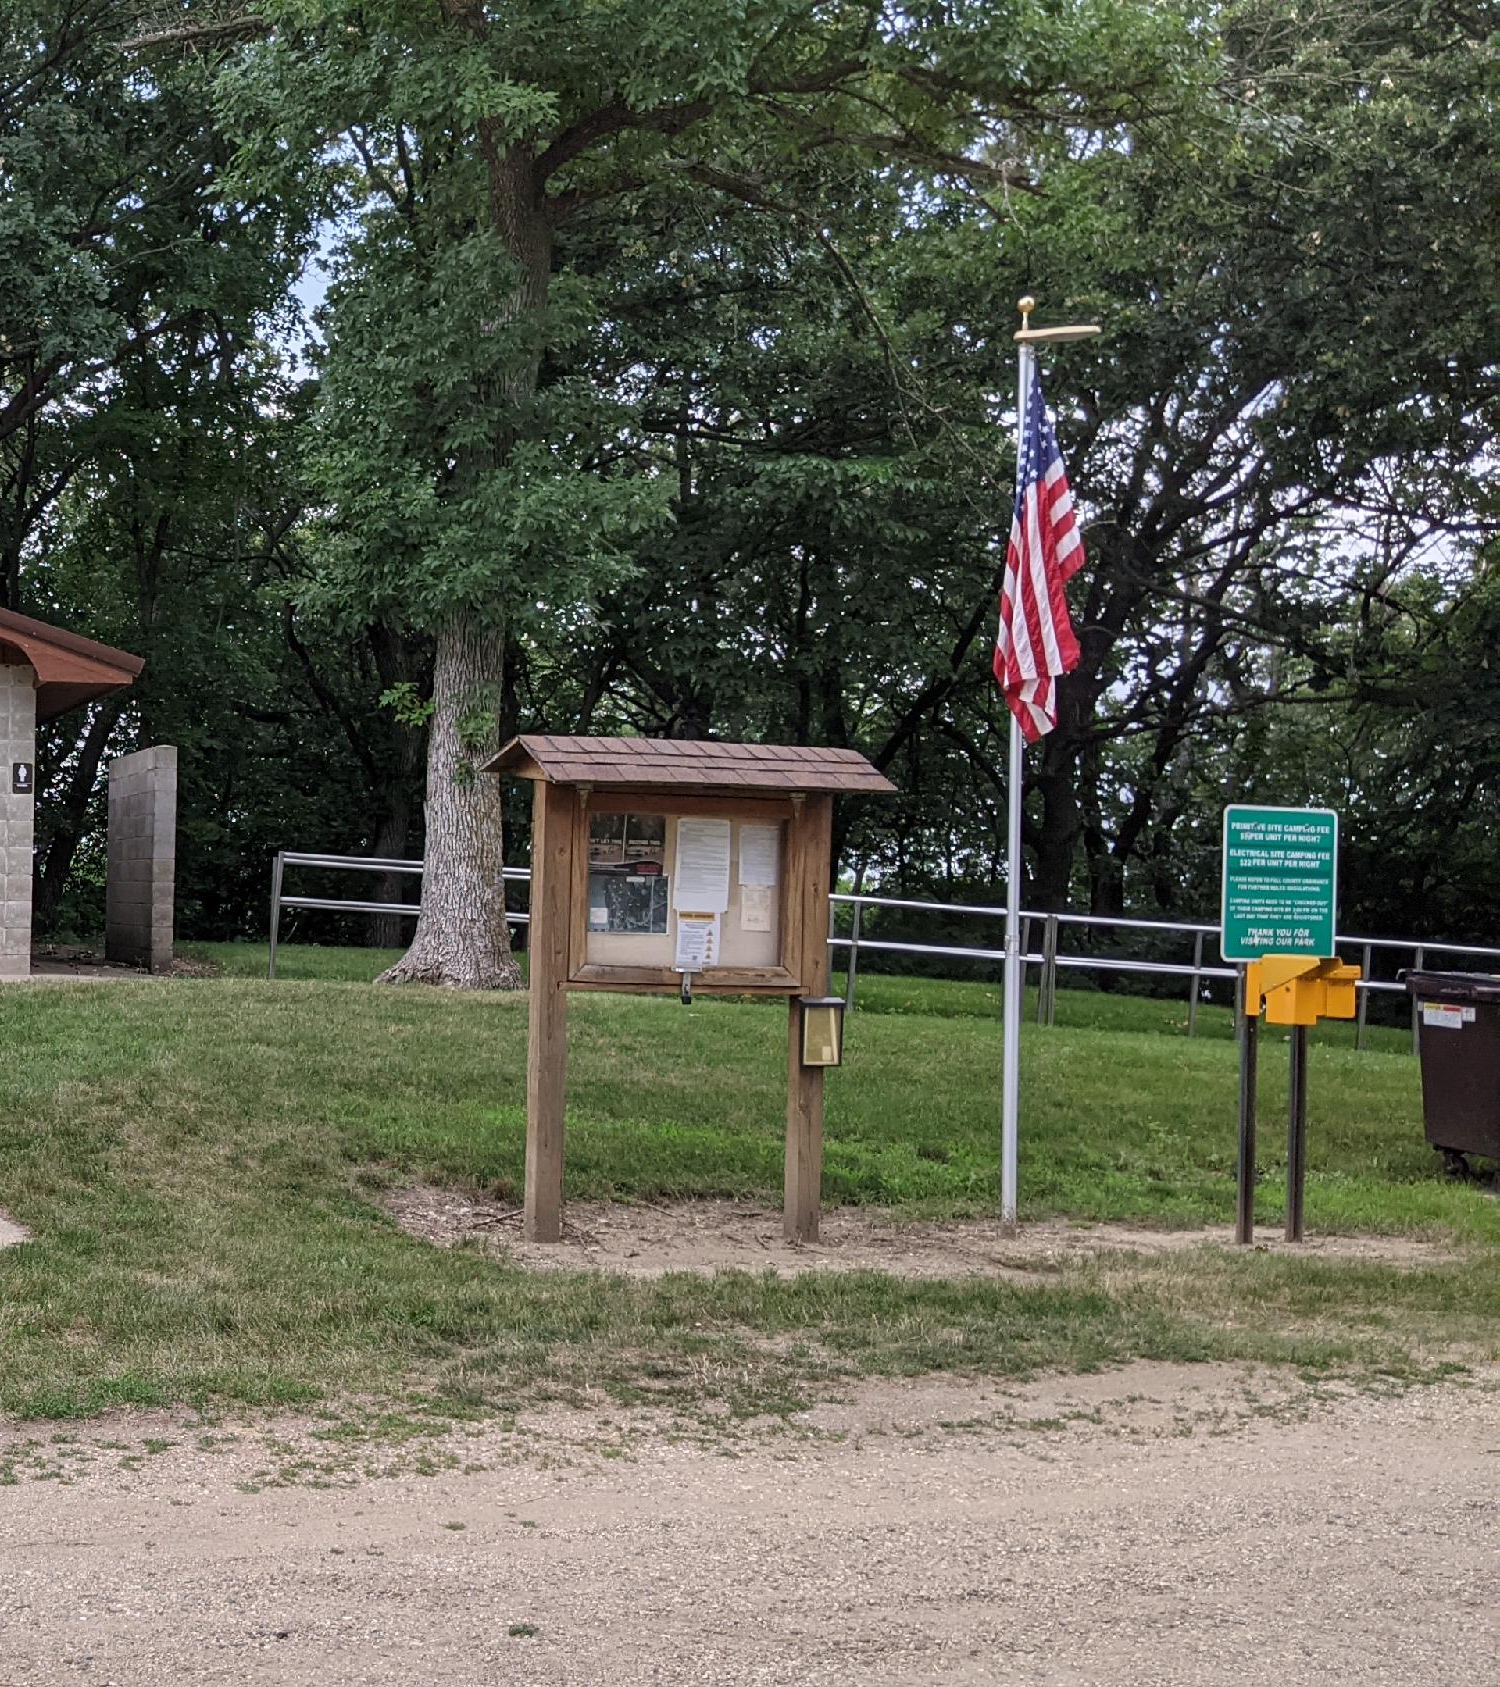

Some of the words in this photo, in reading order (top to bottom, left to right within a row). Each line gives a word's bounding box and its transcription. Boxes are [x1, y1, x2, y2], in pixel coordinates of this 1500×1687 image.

[1267, 824, 1282, 832] SITE
[1316, 826, 1330, 834] FEE
[1265, 833, 1282, 841] UNIT
[1284, 834, 1297, 842] PER
[1298, 835, 1321, 843] NIGHT
[1230, 849, 1269, 858] ELECTRICAL
[1270, 850, 1285, 858] SITE
[1286, 851, 1316, 859] CAMPING
[1298, 860, 1320, 868] NIGHT
[1248, 928, 1274, 936] THANK
[1276, 928, 1292, 937] YOU
[1294, 928, 1310, 937] FOR
[1294, 938, 1315, 946] PARK
